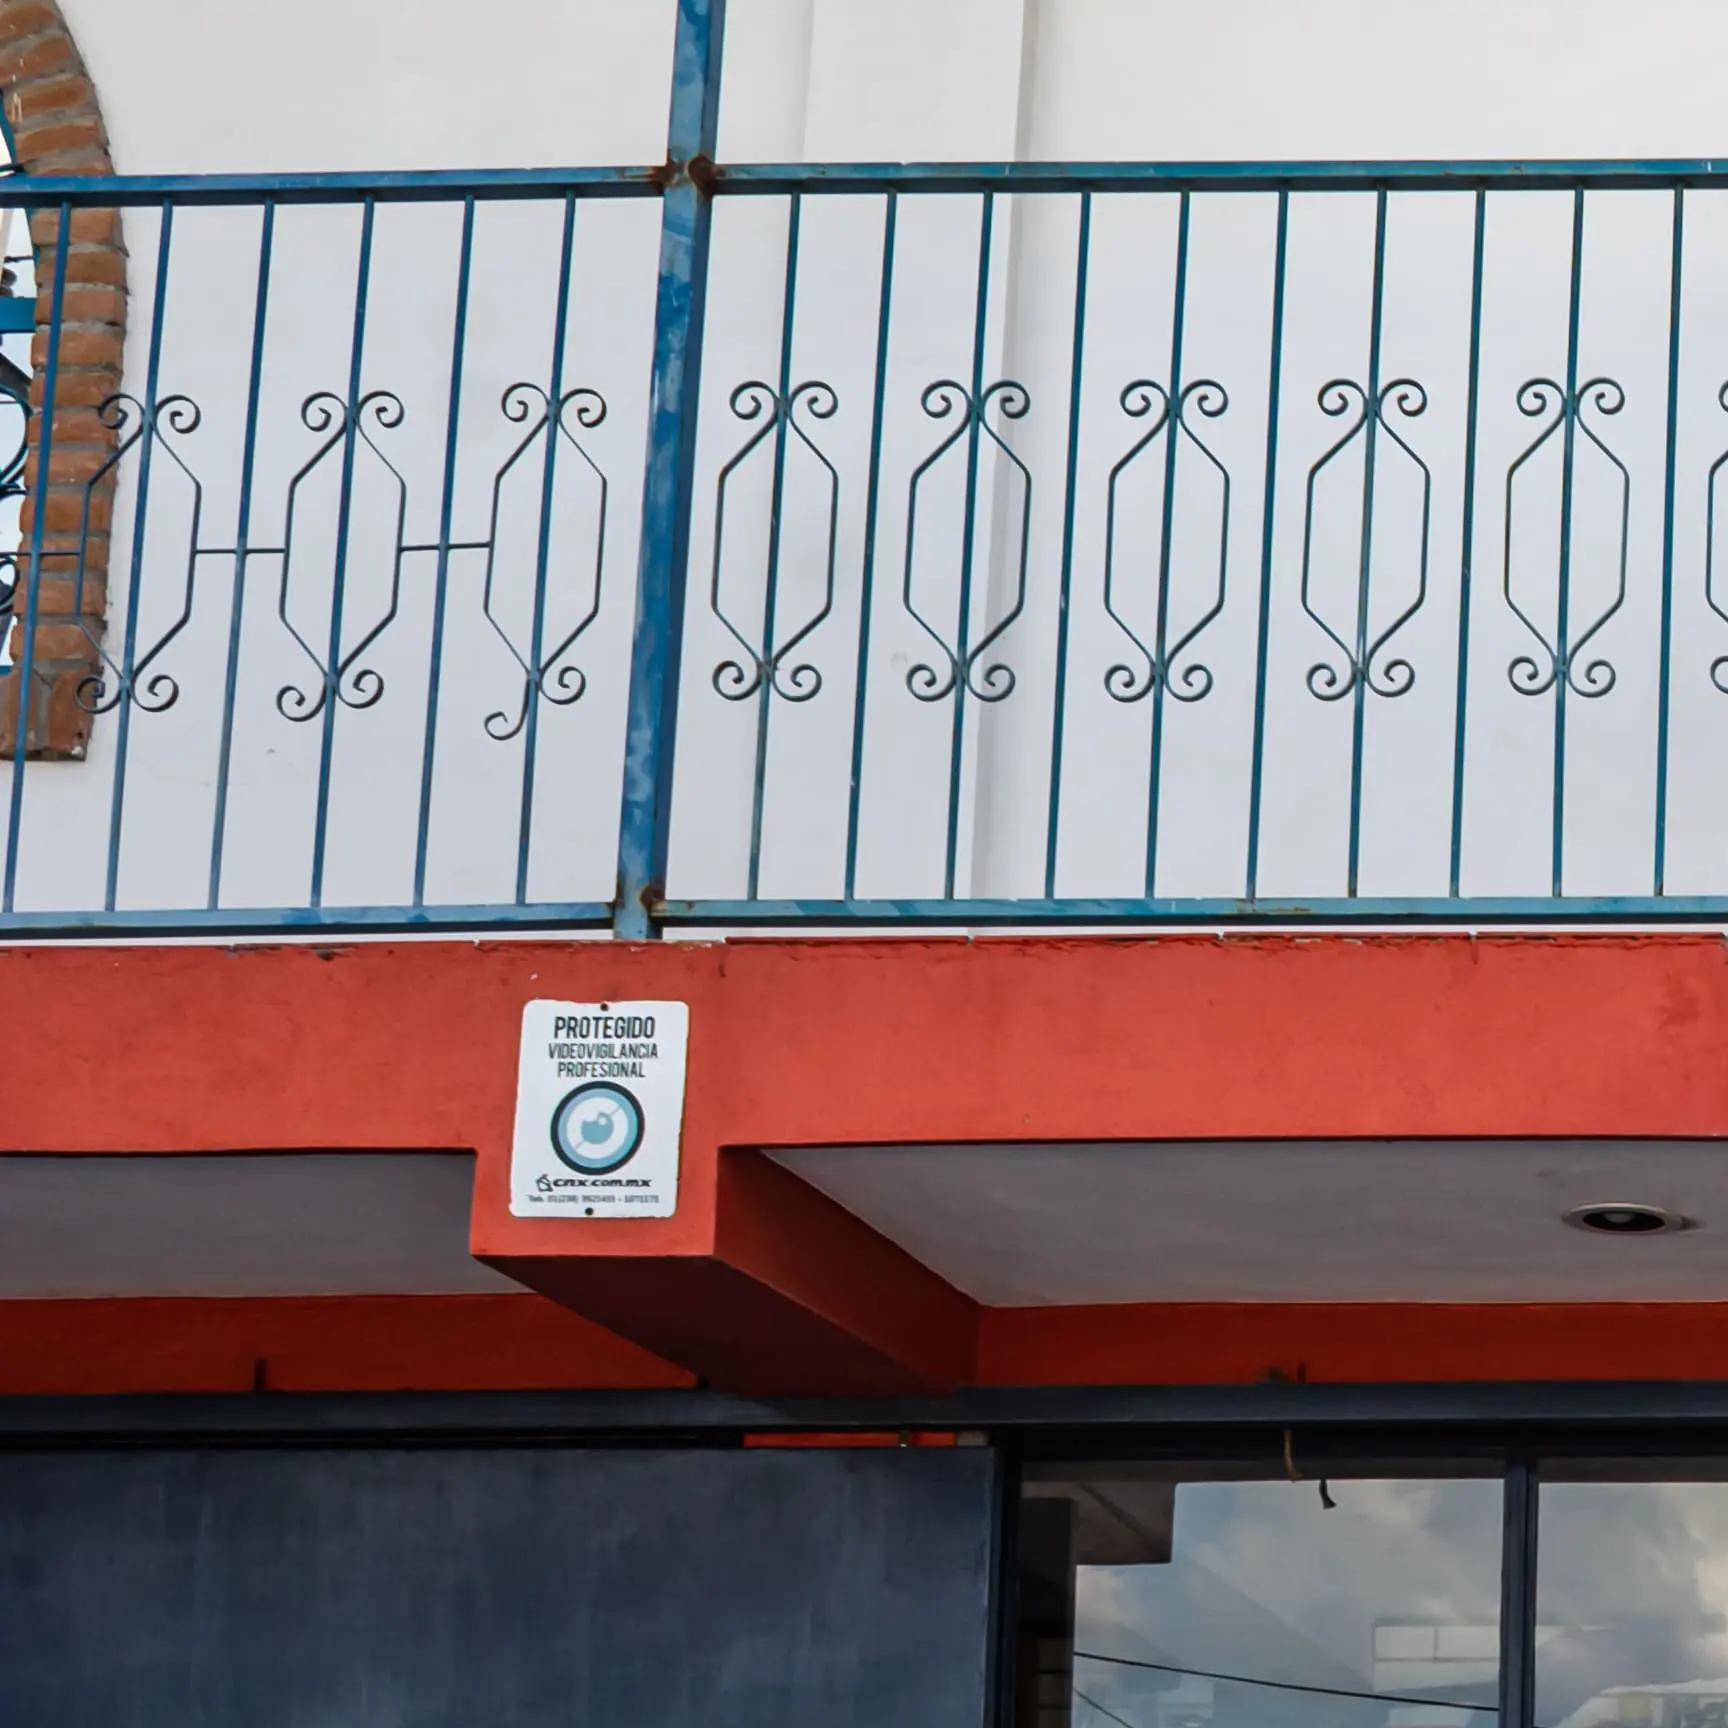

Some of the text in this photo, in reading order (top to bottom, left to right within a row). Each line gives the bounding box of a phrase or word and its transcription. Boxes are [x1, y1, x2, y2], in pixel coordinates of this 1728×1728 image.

[555, 1016, 656, 1038] PROTEGIDO
[548, 1043, 658, 1059] VIDEOVIGILANCIA
[558, 1062, 646, 1077] PROFESIONAL
